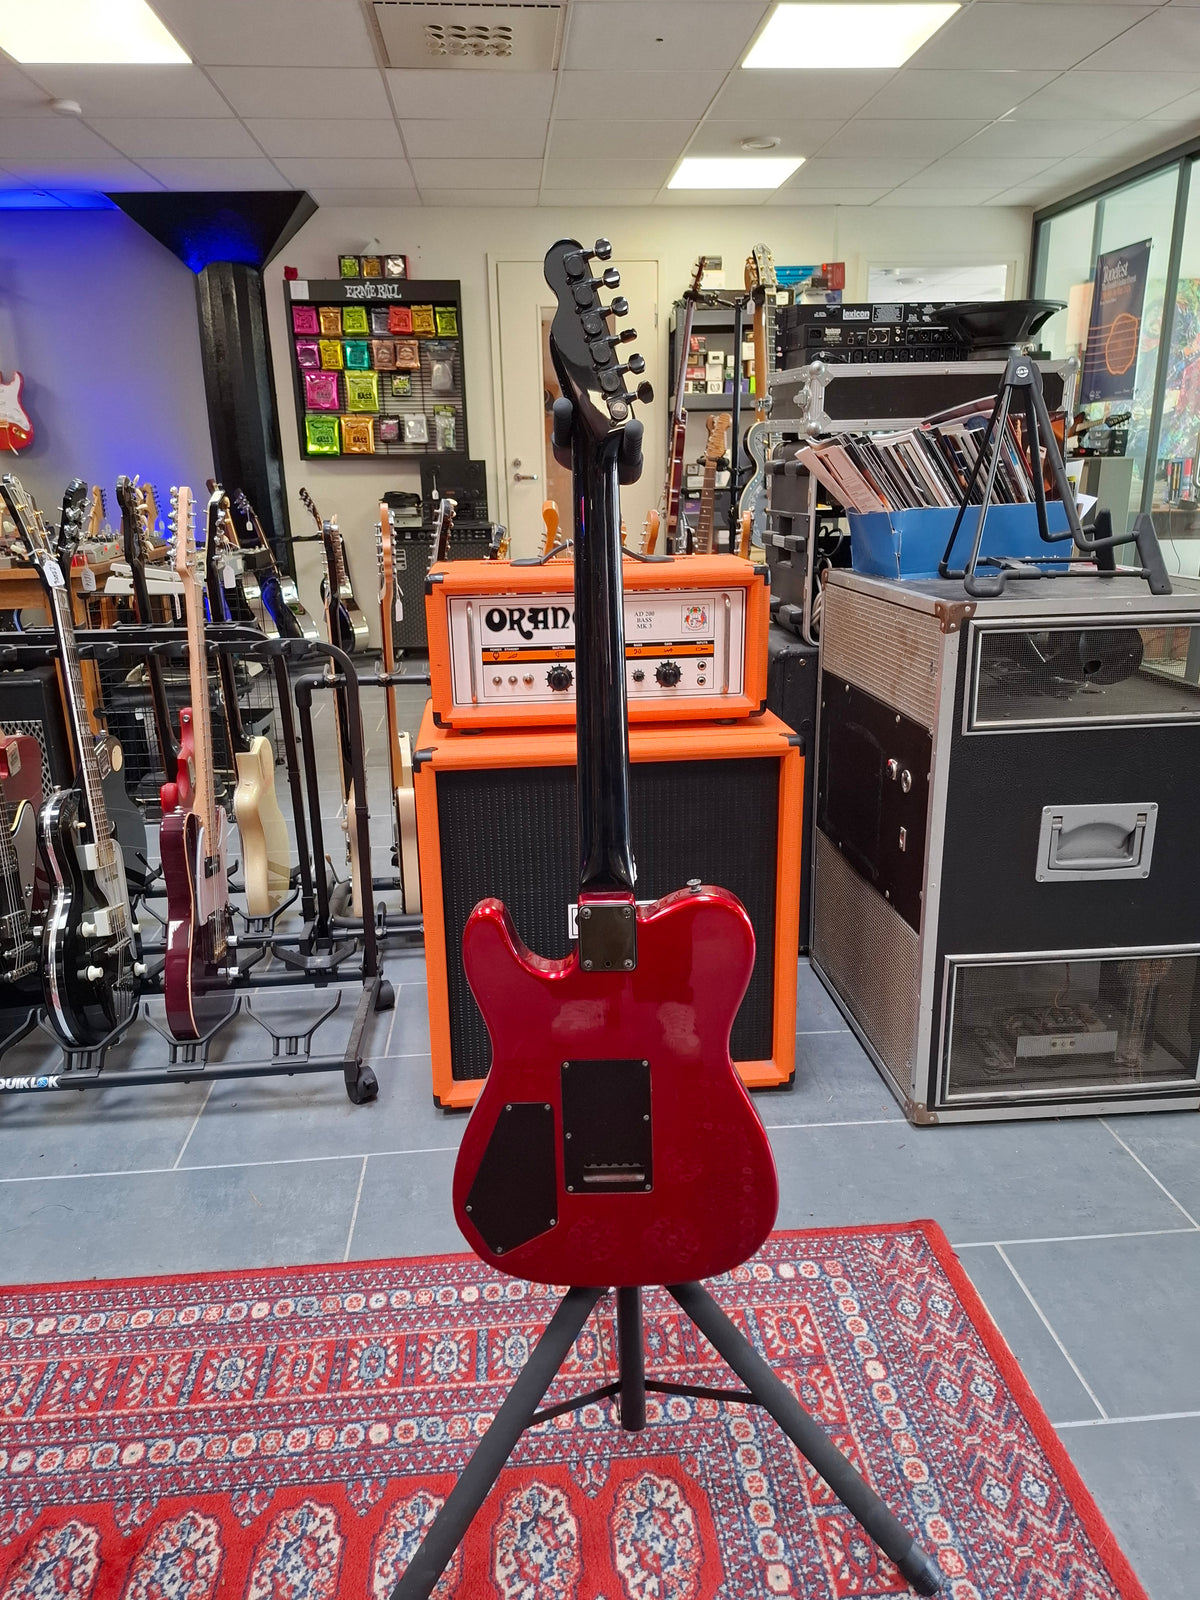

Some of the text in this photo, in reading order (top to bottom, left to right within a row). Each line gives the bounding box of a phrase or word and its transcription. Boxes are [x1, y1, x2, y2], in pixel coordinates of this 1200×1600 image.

[344, 281, 402, 299] ERNIE BALL
[842, 308, 870, 320] lexicon
[357, 392, 373, 400] BASS
[485, 606, 575, 640] ORAN
